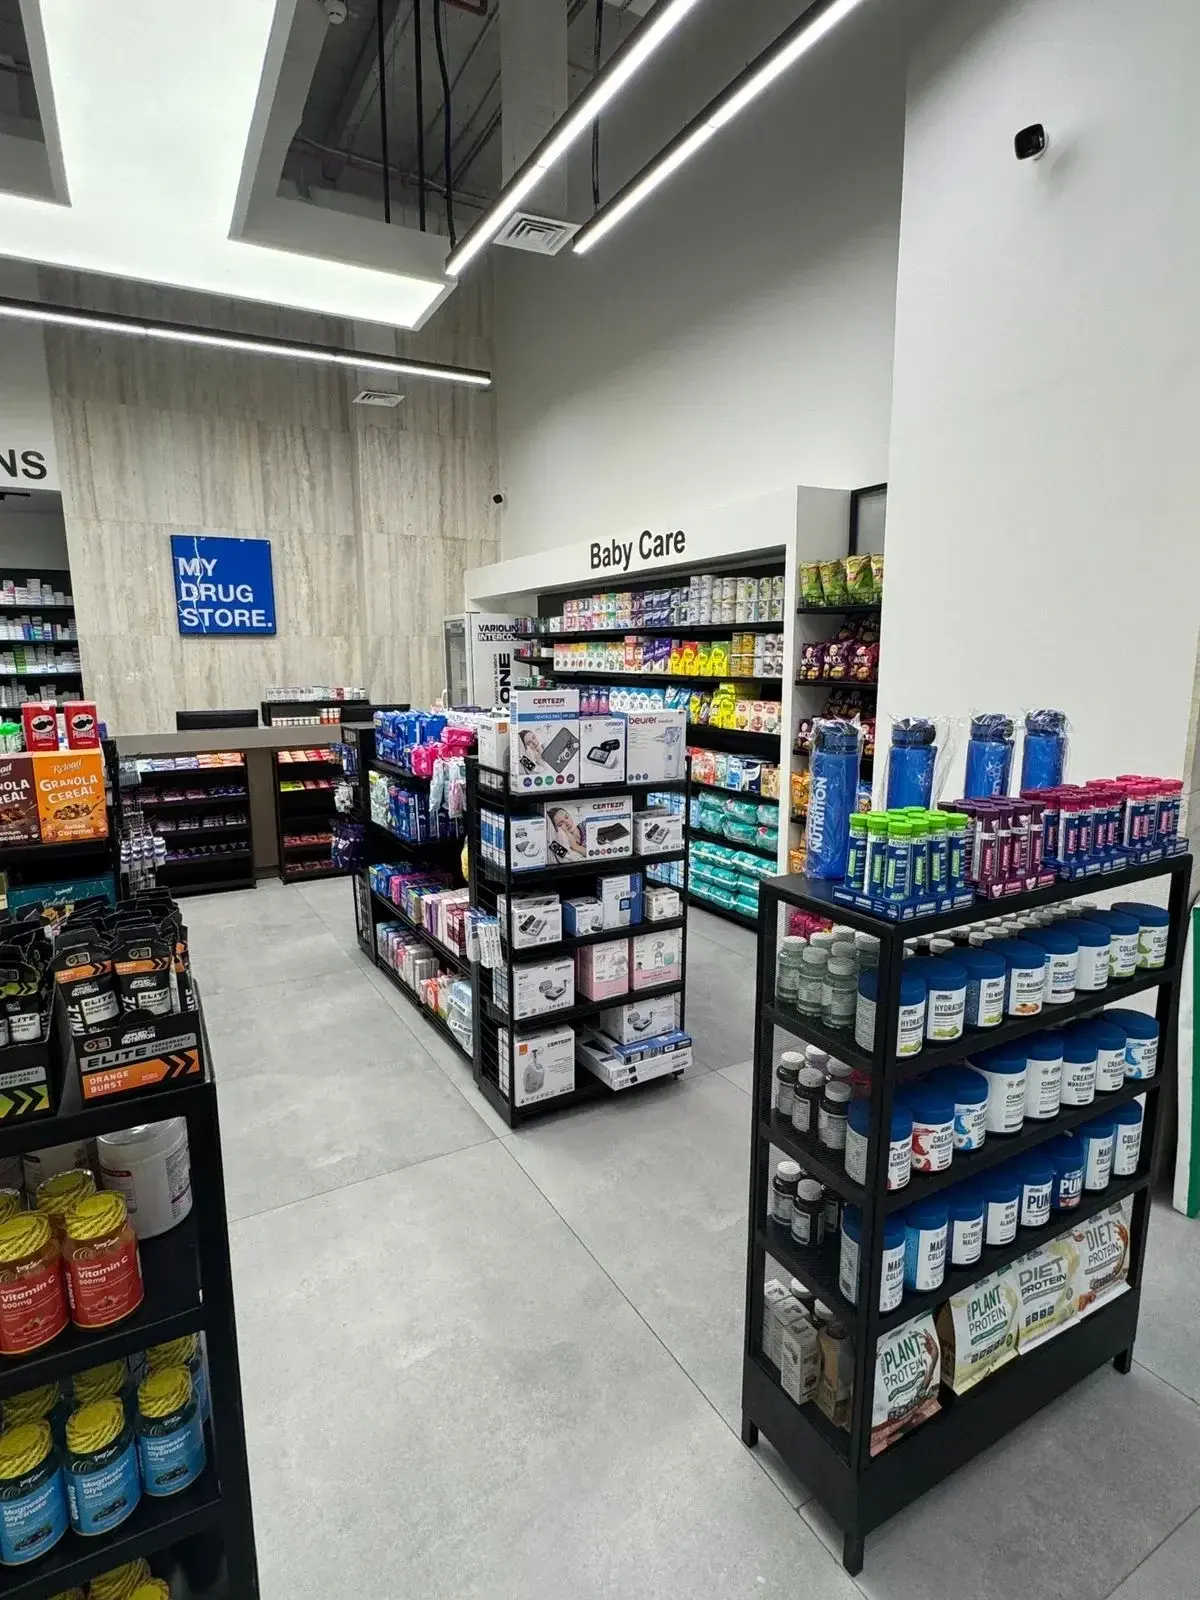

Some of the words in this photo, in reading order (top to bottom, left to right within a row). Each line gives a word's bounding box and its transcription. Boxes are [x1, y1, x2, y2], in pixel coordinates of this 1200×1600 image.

[590, 538, 633, 571] Baby
[639, 530, 686, 560] Care
[178, 557, 218, 577] MY
[181, 583, 254, 603] DRUG
[182, 608, 273, 628] STORE.
[498, 653, 511, 704] ONE
[533, 697, 565, 705] CERTEZA
[628, 715, 657, 725] beurer
[40, 775, 98, 791] GRANOLA
[0, 791, 28, 804] EAL
[48, 786, 96, 804] CEREAL
[592, 801, 625, 809] CERTEZA
[810, 776, 828, 853] NUTRITION
[57, 828, 94, 837] Caramel
[84, 994, 114, 1007] ELITE
[141, 990, 169, 1000] ELITE
[10, 1014, 38, 1024] LITE
[87, 1047, 147, 1067] ELITE
[89, 1070, 129, 1085] ORANGE
[90, 1081, 122, 1093] BURST
[1085, 1220, 1114, 1252] DIET
[1087, 1242, 1120, 1266] PROTEIN
[78, 1262, 120, 1279] Vitamin
[121, 1255, 128, 1263] C
[1019, 1257, 1065, 1286] DIET
[0, 1282, 47, 1303] Vitamin
[48, 1275, 55, 1284] C
[79, 1276, 106, 1285] 500mg
[1020, 1273, 1067, 1297] PROTEIN
[2, 1298, 32, 1310] 500mg
[971, 1285, 1001, 1320] PLANT
[968, 1305, 1007, 1336] PROTEIN
[884, 1334, 921, 1374] PLANT
[883, 1358, 925, 1391] PROTEIN
[82, 1459, 129, 1489] Magnesium
[83, 1472, 123, 1495] Glycinate
[3, 1486, 54, 1516] Magnesium
[4, 1500, 48, 1524] Glycinate
